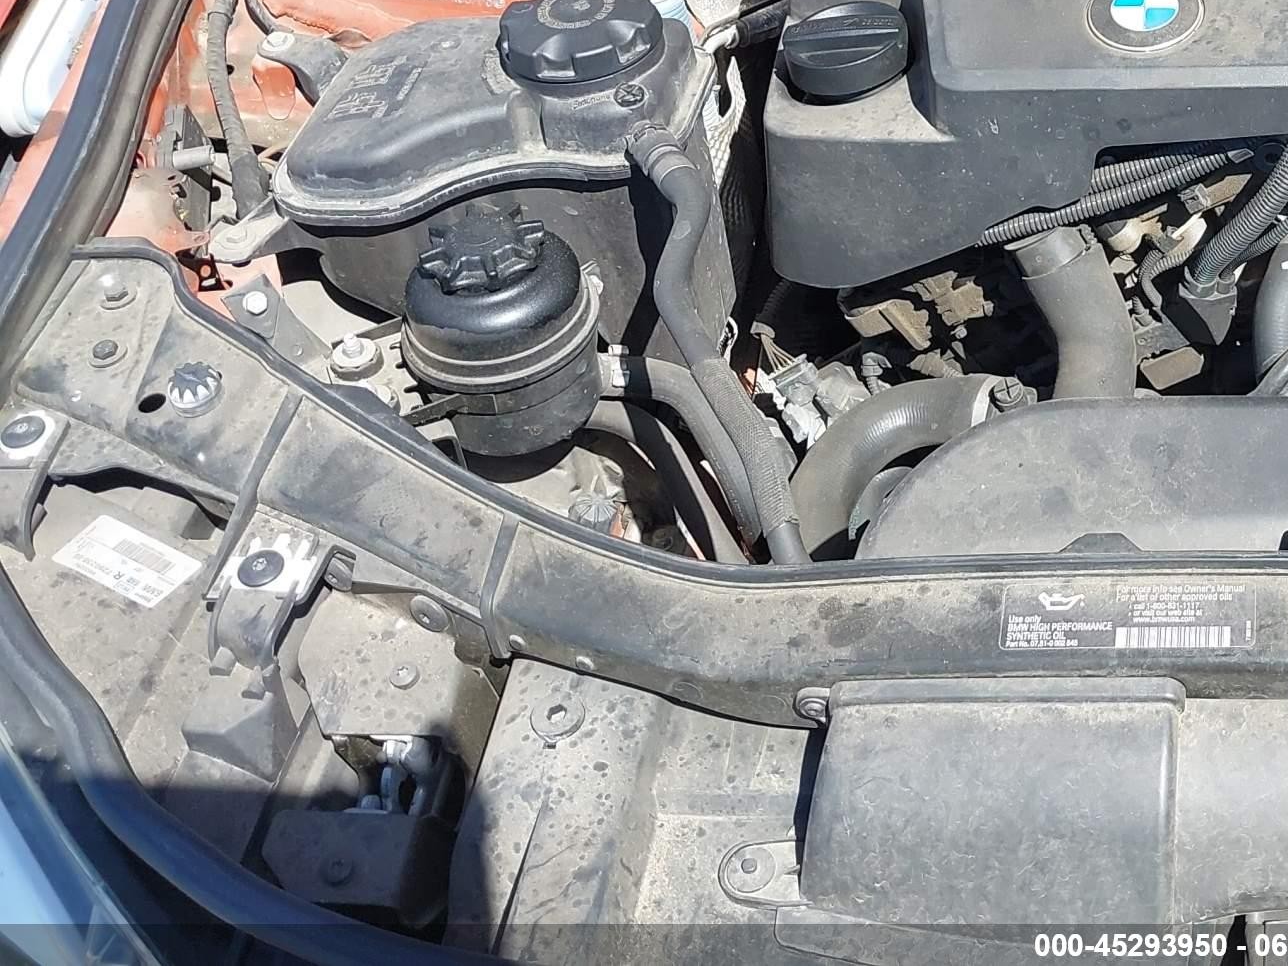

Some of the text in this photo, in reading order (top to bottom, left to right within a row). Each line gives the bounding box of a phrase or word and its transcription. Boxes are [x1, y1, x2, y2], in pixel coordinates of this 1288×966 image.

[1216, 584, 1246, 593] Manual
[1160, 592, 1180, 601] other
[1181, 592, 1218, 602] approved
[1008, 614, 1042, 625] Use only
[1007, 621, 1113, 632] BMW HIGH PERFORMANCE
[1006, 631, 1066, 641] SYNTHETIC OIL
